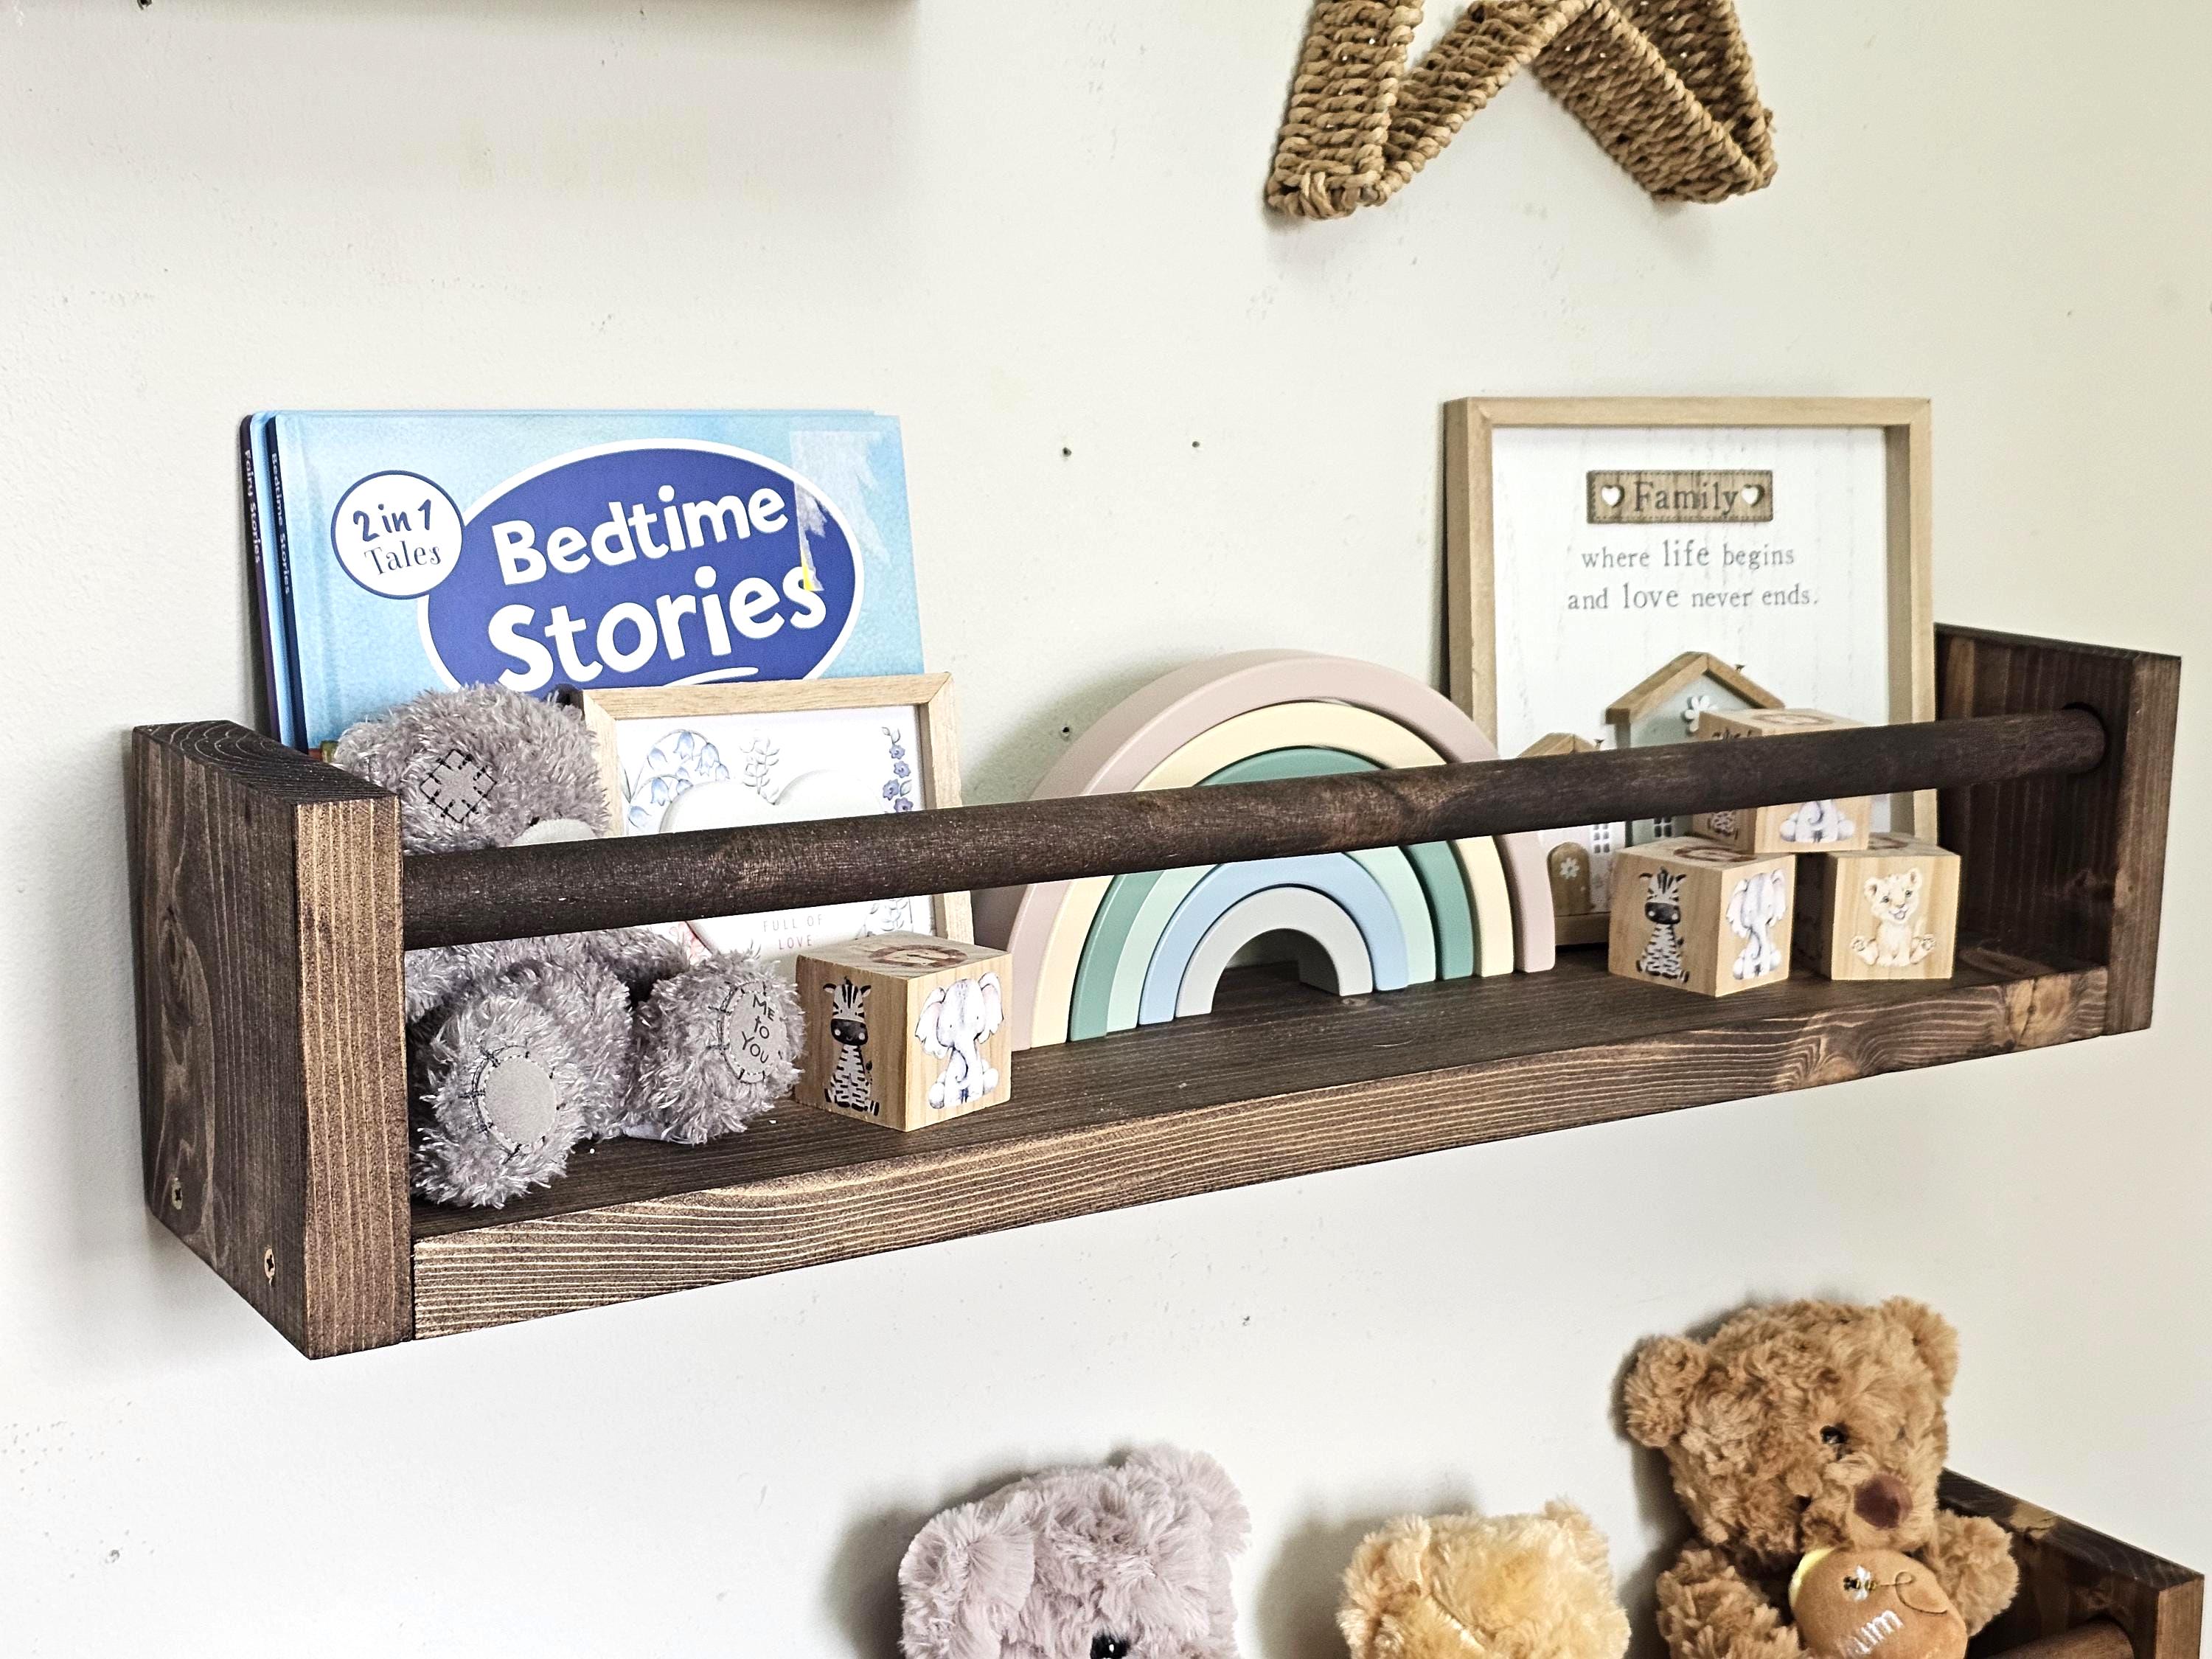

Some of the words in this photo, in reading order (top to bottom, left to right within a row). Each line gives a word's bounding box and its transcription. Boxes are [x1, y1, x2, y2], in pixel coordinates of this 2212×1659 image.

[245, 450, 254, 496] Fairy
[250, 502, 262, 563] Stories
[1634, 481, 1739, 515] Family
[271, 453, 283, 526] Bedtime
[279, 532, 290, 595] Stories
[352, 509, 380, 542] 2
[378, 503, 412, 533] in
[417, 498, 432, 531] 1
[491, 484, 788, 585] Bedtime
[364, 540, 442, 575] Tales
[1582, 546, 1649, 568] where
[1662, 539, 1710, 567] life
[1722, 542, 1795, 571] begins
[1568, 587, 1609, 610] and
[1623, 582, 1680, 609] love
[1691, 590, 1753, 608] never
[1761, 582, 1818, 606] ends.
[488, 566, 827, 692] Stories
[763, 919, 797, 932] FULL
[807, 914, 822, 927] OF
[778, 934, 813, 950] LOVE
[752, 993, 776, 1022] ME
[741, 1031, 769, 1064] YOU
